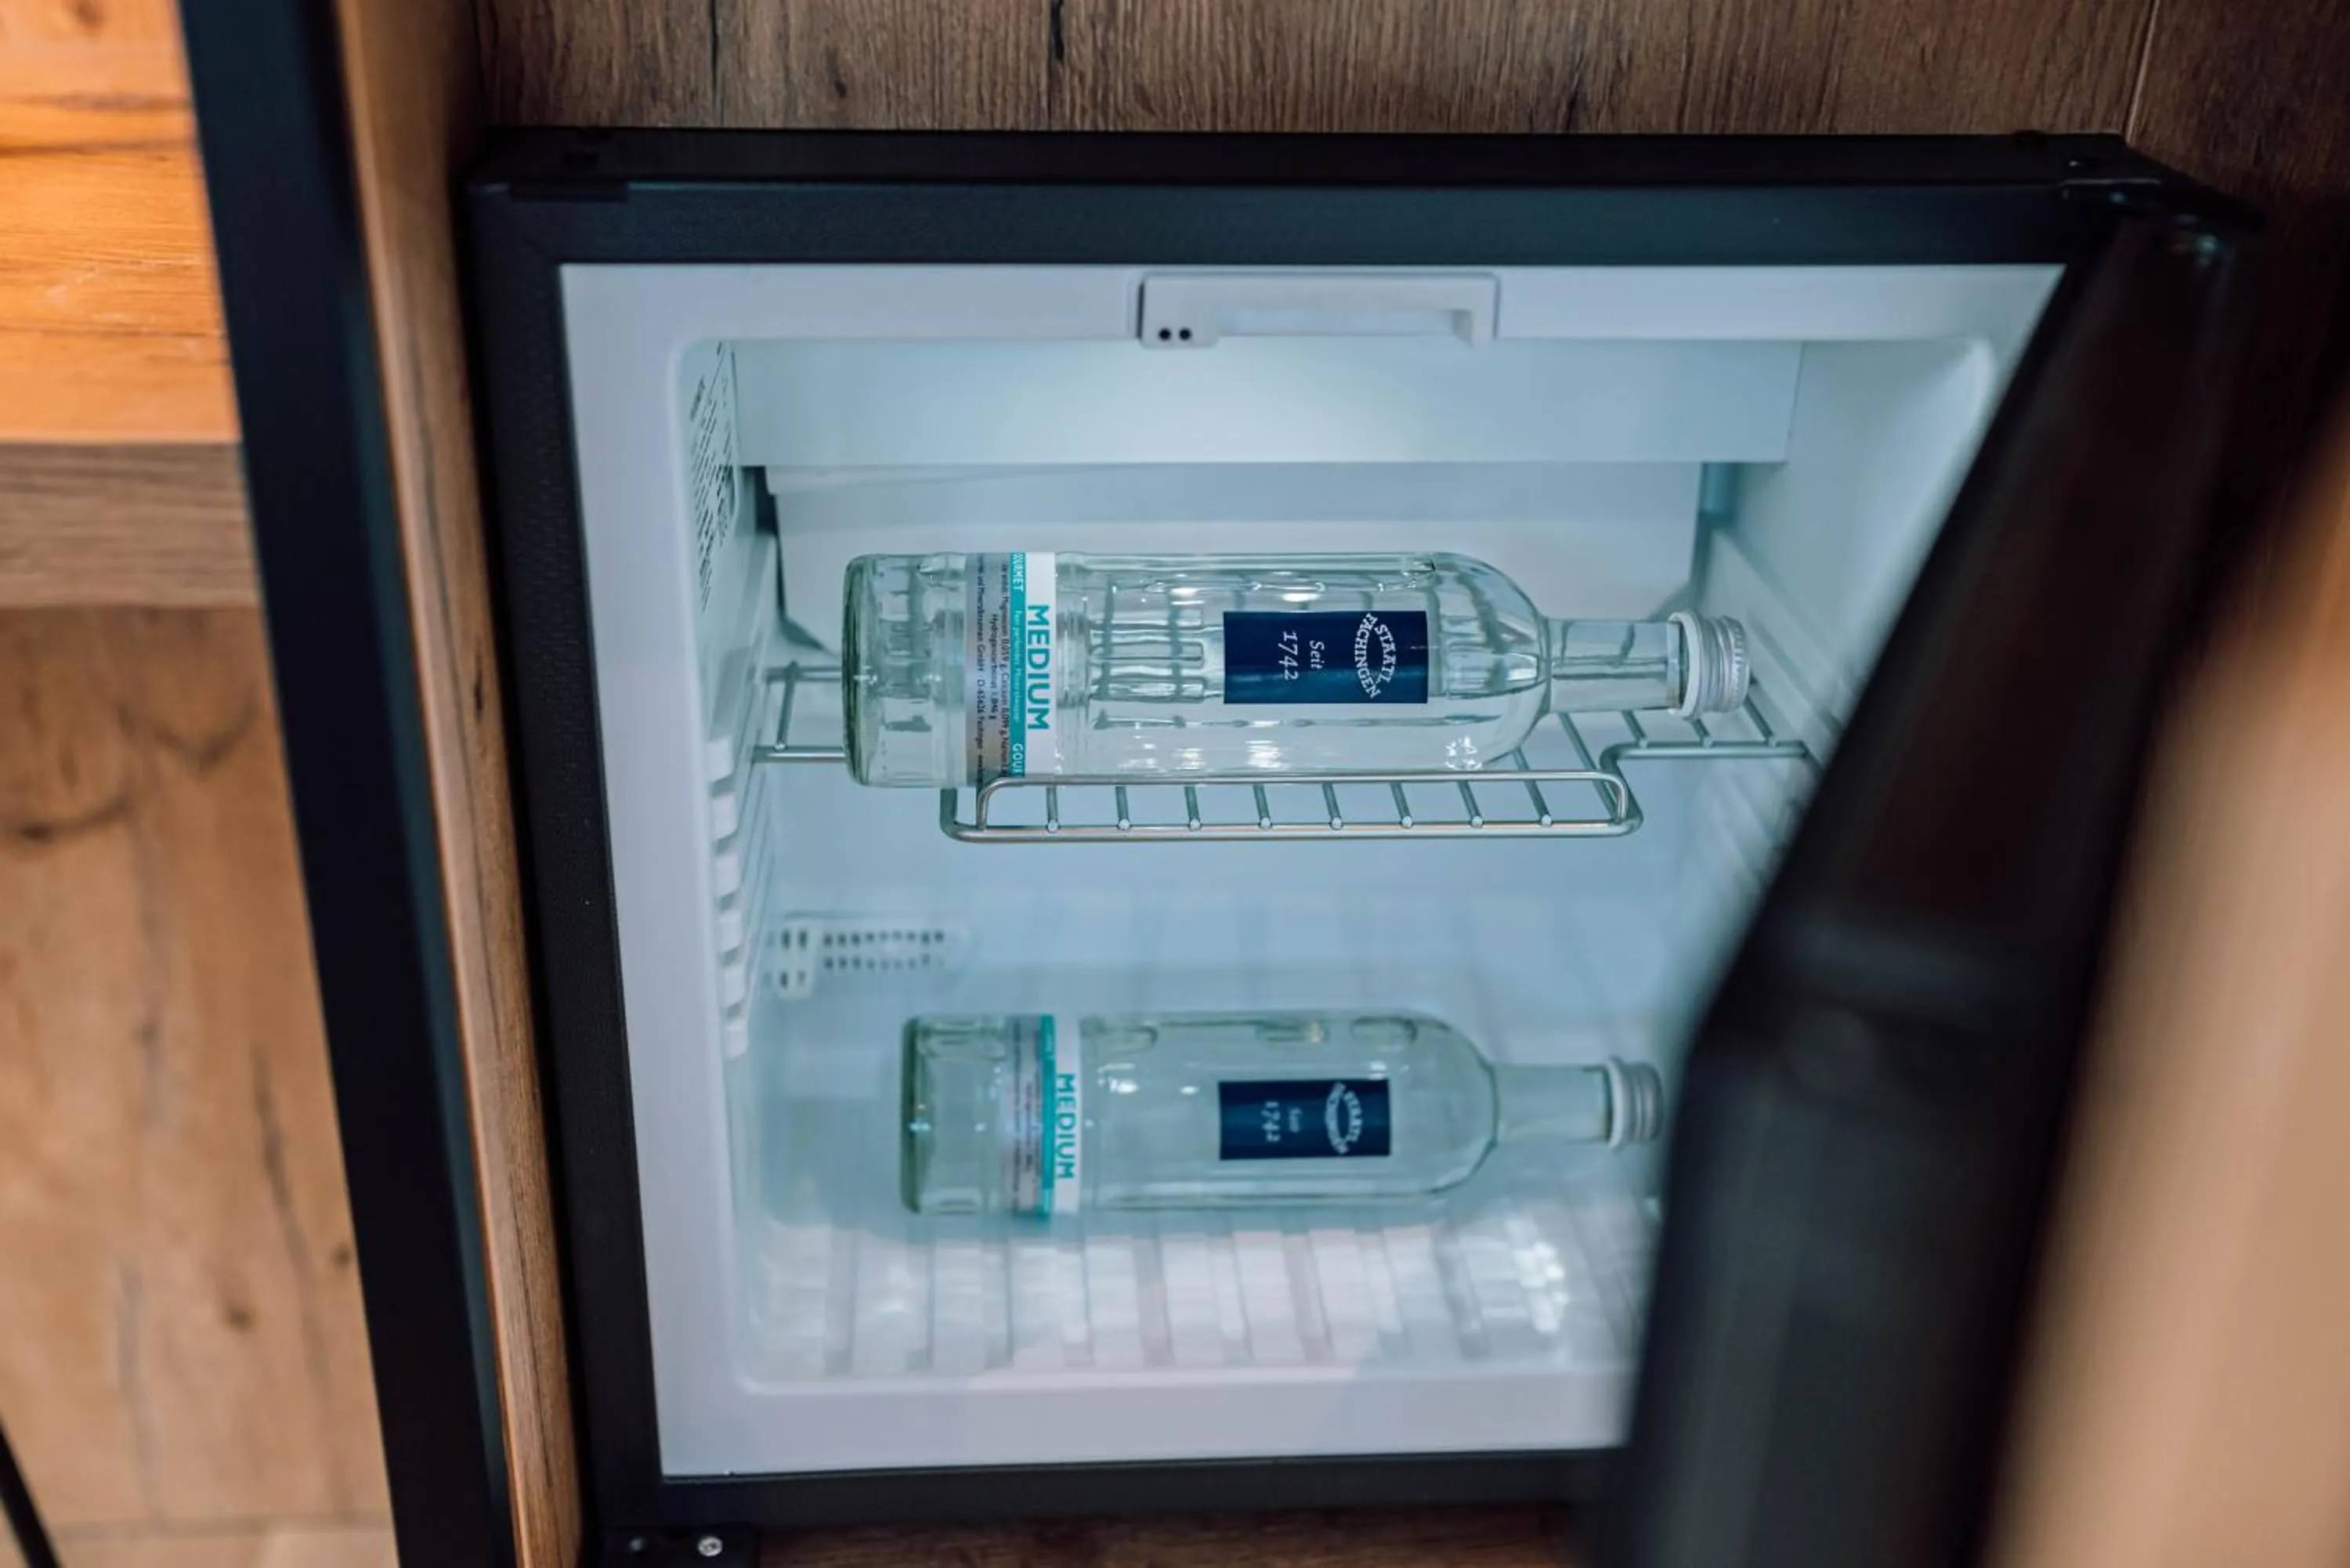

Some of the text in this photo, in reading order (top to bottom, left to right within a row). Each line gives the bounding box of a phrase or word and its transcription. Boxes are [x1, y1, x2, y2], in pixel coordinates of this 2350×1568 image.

[1028, 605, 1050, 730] MEDIUM
[1278, 630, 1298, 681] 1742
[1310, 640, 1325, 670] Seit
[1354, 613, 1380, 698] FACHINGEN
[1058, 1073, 1076, 1179] MEDIUM
[1260, 1100, 1281, 1142] 1742
